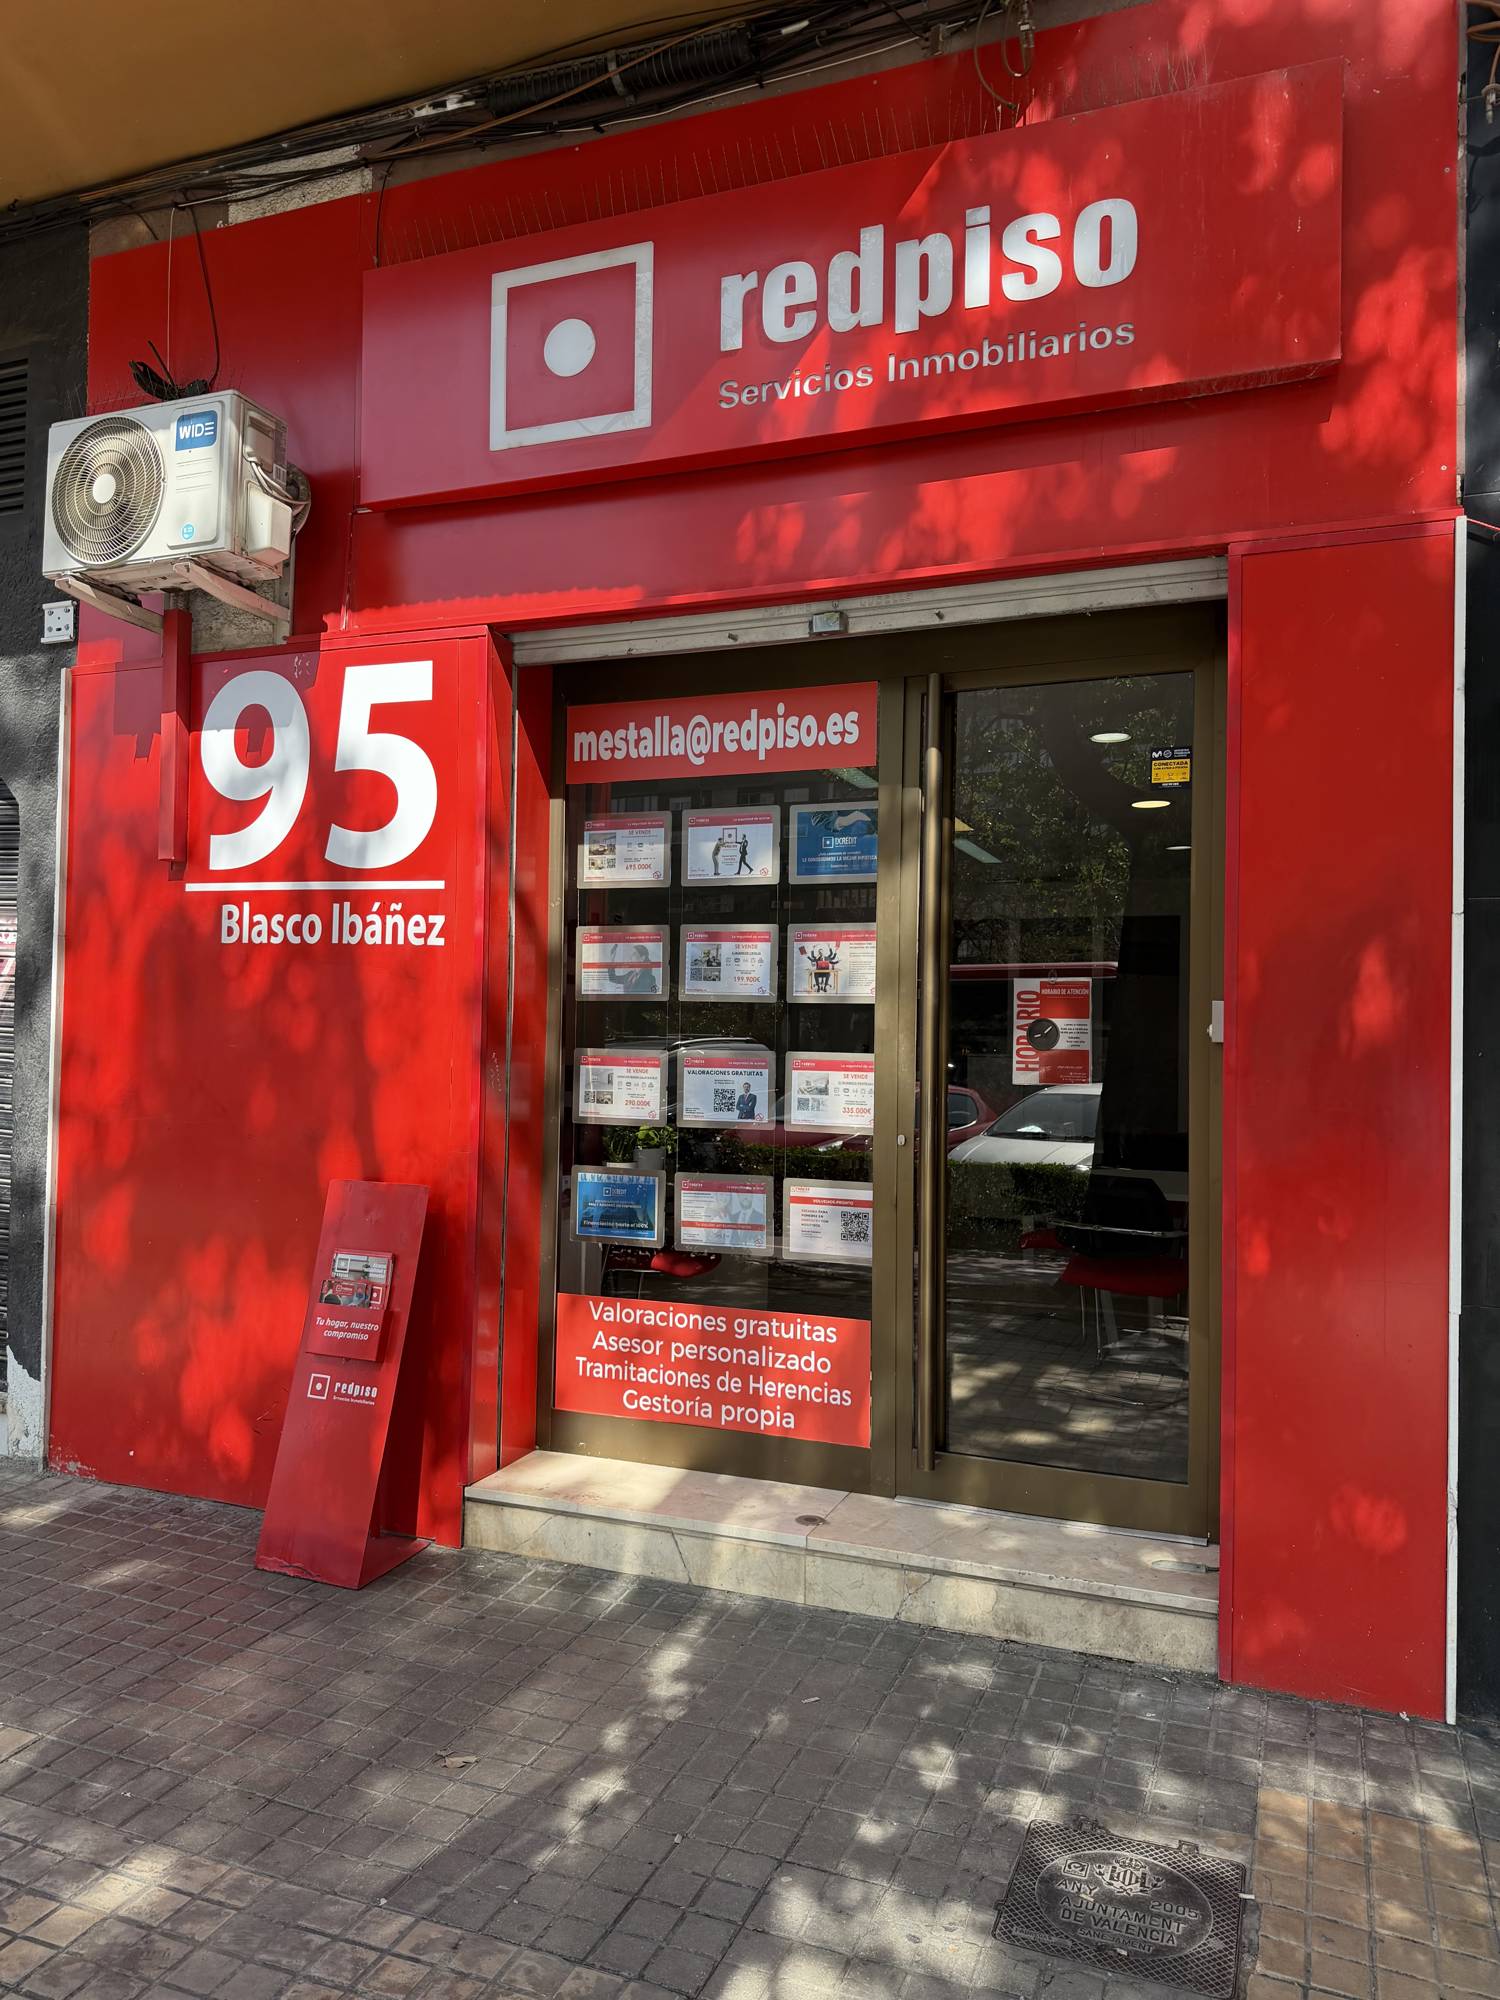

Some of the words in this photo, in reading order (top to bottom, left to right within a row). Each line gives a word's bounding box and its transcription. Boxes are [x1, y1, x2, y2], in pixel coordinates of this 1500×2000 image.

[719, 197, 1139, 352] redpiso
[718, 362, 874, 410] Servicios
[887, 320, 1136, 383] Inmobiliarios
[179, 421, 215, 440] WIDE
[573, 702, 859, 765] mestalla@redpiso.es
[200, 660, 438, 871] 95
[221, 901, 323, 945] Blasco
[331, 901, 446, 946] Ibáñez
[315, 1316, 325, 1326] Tu
[325, 1318, 349, 1330] hogar,
[350, 1319, 379, 1331] nuestro
[323, 1330, 369, 1341] compromiso
[588, 1301, 727, 1332] Valoraciones
[733, 1316, 837, 1343] gratuitas
[592, 1330, 664, 1355] Asesor
[671, 1339, 831, 1374] personalizado
[334, 1381, 378, 1398] redpiso
[575, 1356, 710, 1389] Tramitaciones
[716, 1371, 742, 1393] de
[749, 1373, 852, 1406] Herencias
[622, 1389, 712, 1418] Gestoría
[721, 1402, 796, 1430] propia
[1057, 1878, 1098, 1896] ANY
[1060, 1895, 1186, 1935] AJUNTAMENT
[1061, 1908, 1084, 1923] DE
[1090, 1914, 1178, 1946] VALENCIA
[1150, 1900, 1199, 1920] 2005
